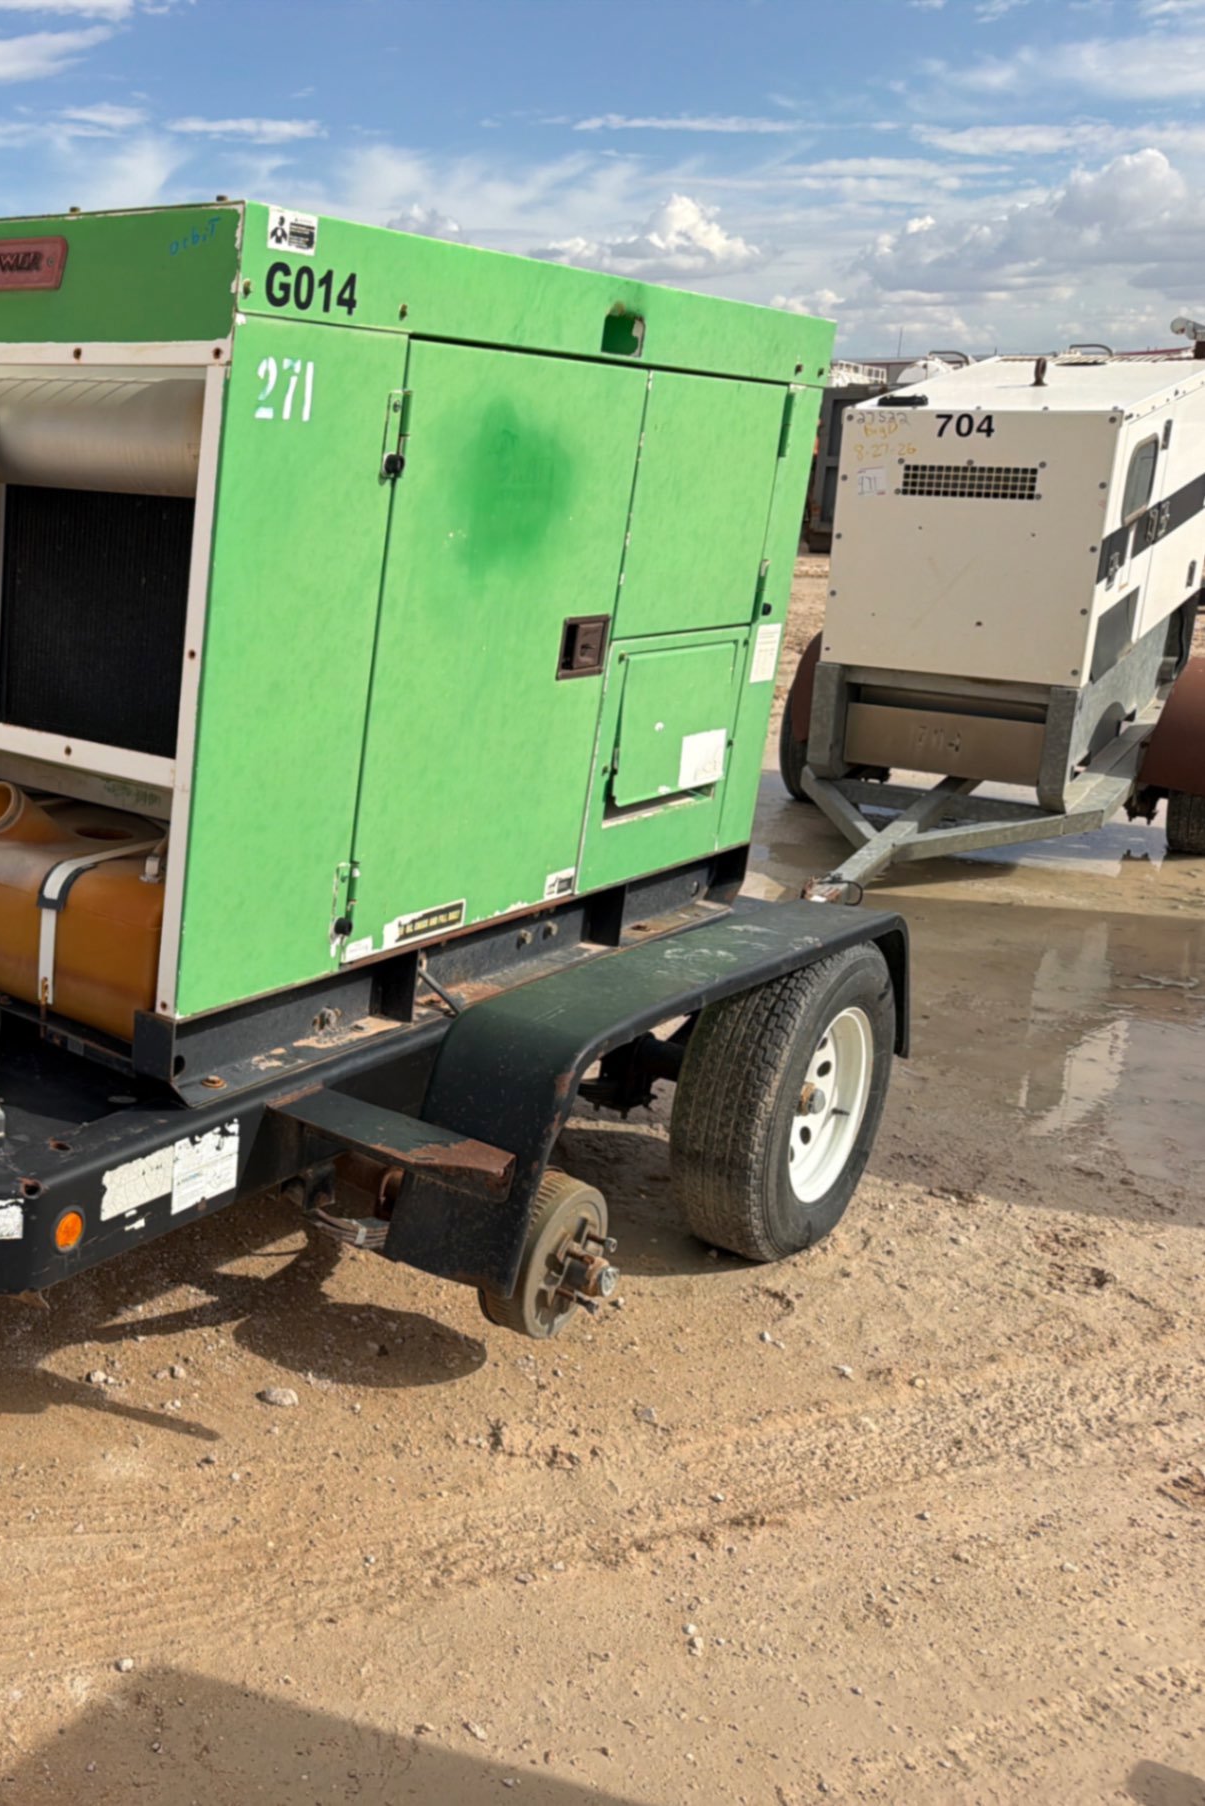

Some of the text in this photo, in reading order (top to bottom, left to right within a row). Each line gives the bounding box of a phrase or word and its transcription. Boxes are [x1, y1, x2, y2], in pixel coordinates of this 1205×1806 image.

[265, 261, 357, 316] G014
[254, 356, 315, 422] 271
[935, 413, 995, 438] 704
